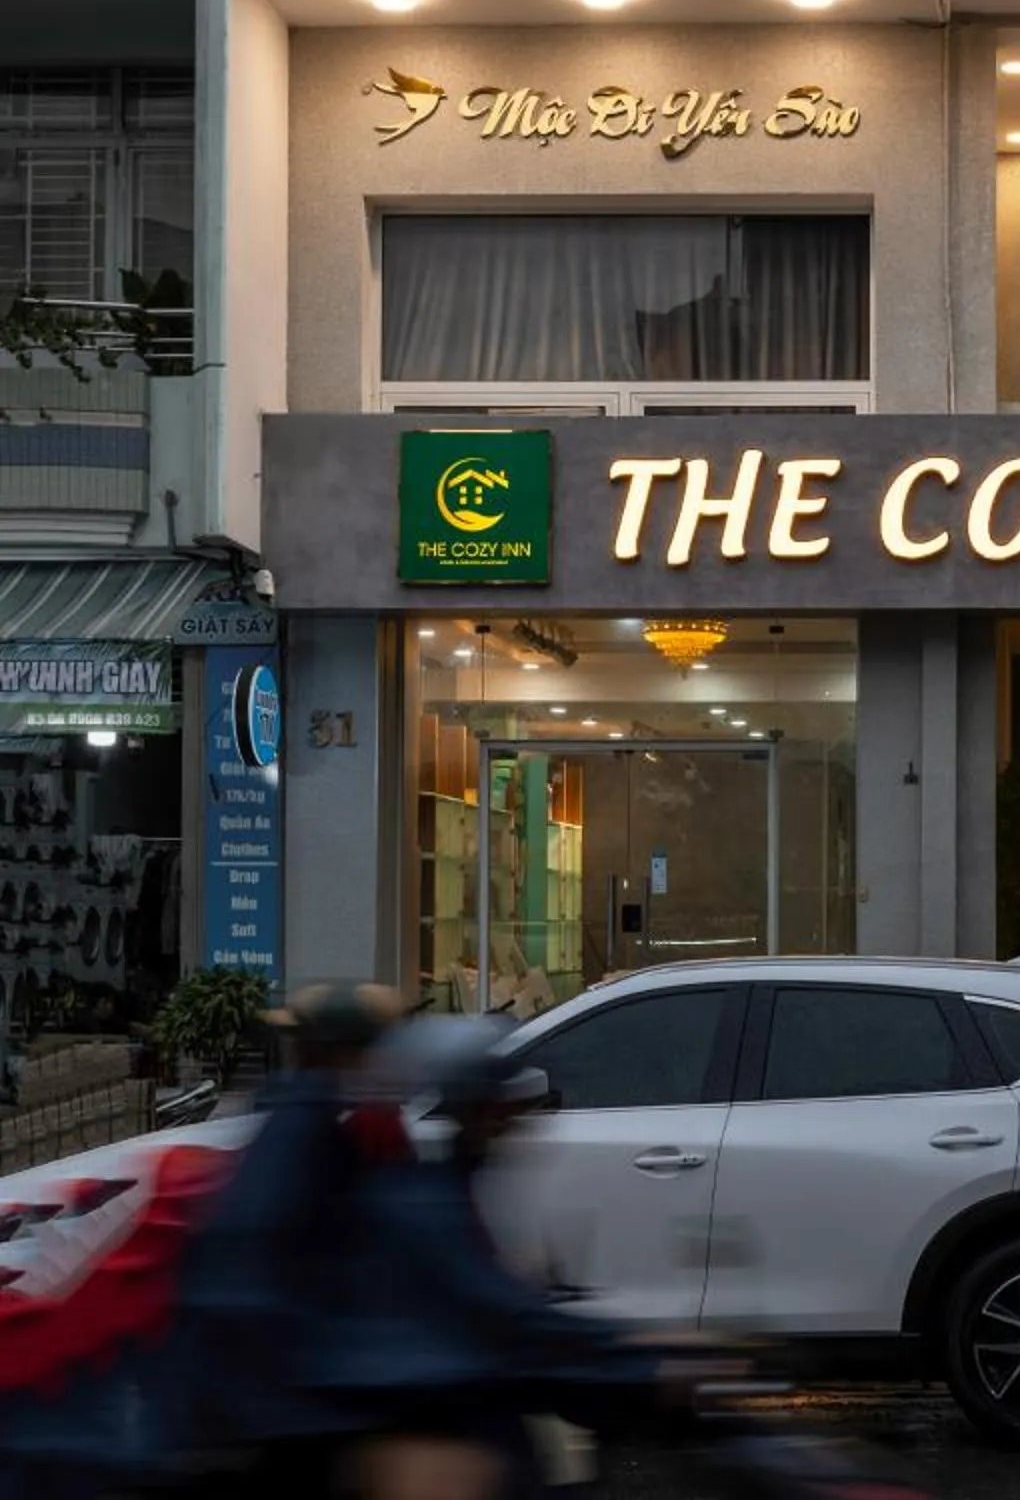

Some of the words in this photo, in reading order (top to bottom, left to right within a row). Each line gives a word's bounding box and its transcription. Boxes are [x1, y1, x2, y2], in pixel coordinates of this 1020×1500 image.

[609, 449, 842, 568] THE
[417, 541, 447, 557] THE
[452, 541, 498, 557] COZY
[502, 541, 531, 557] INN
